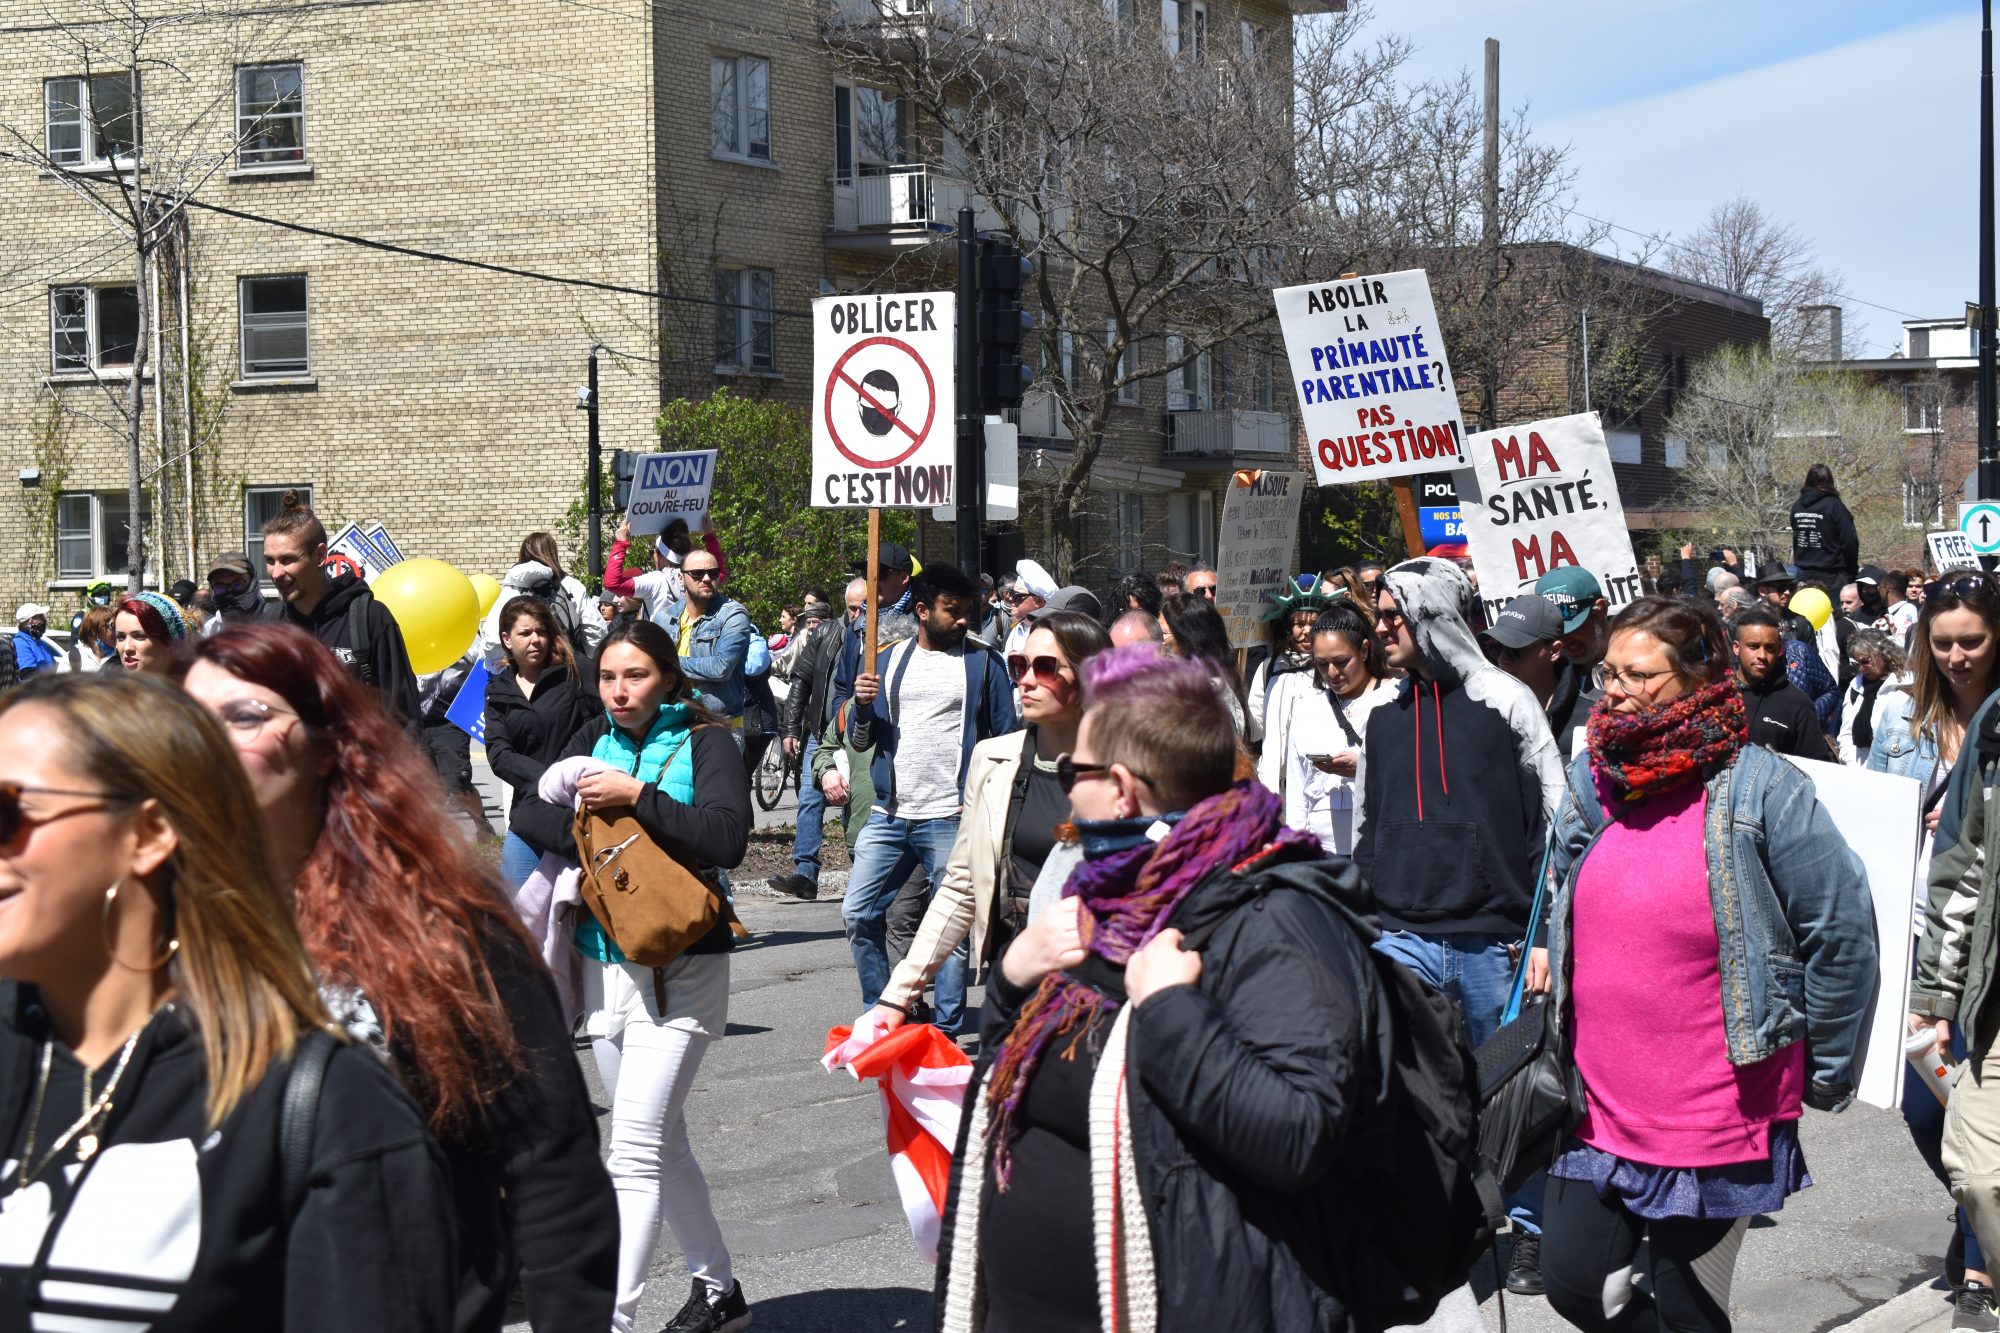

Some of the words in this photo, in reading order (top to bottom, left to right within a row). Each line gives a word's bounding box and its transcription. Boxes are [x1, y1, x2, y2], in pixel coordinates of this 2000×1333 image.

[1344, 314, 1369, 332] LA
[1302, 361, 1446, 404] PARENTALE?
[1357, 405, 1395, 428] PAS
[1491, 431, 1561, 480] MA
[646, 458, 704, 486] NON
[664, 490, 677, 499] AU
[825, 472, 891, 504] C'EST
[894, 465, 952, 504] NON!
[1250, 476, 1290, 497] MASQUE
[1425, 484, 1456, 496] POL
[632, 498, 704, 515] COUVRE-FEU
[1488, 469, 1608, 526] SANTÉ,
[1434, 511, 1449, 520] NOS
[1446, 522, 1466, 536] BA
[1512, 530, 1581, 580] MA
[1934, 536, 1971, 559] FREE
